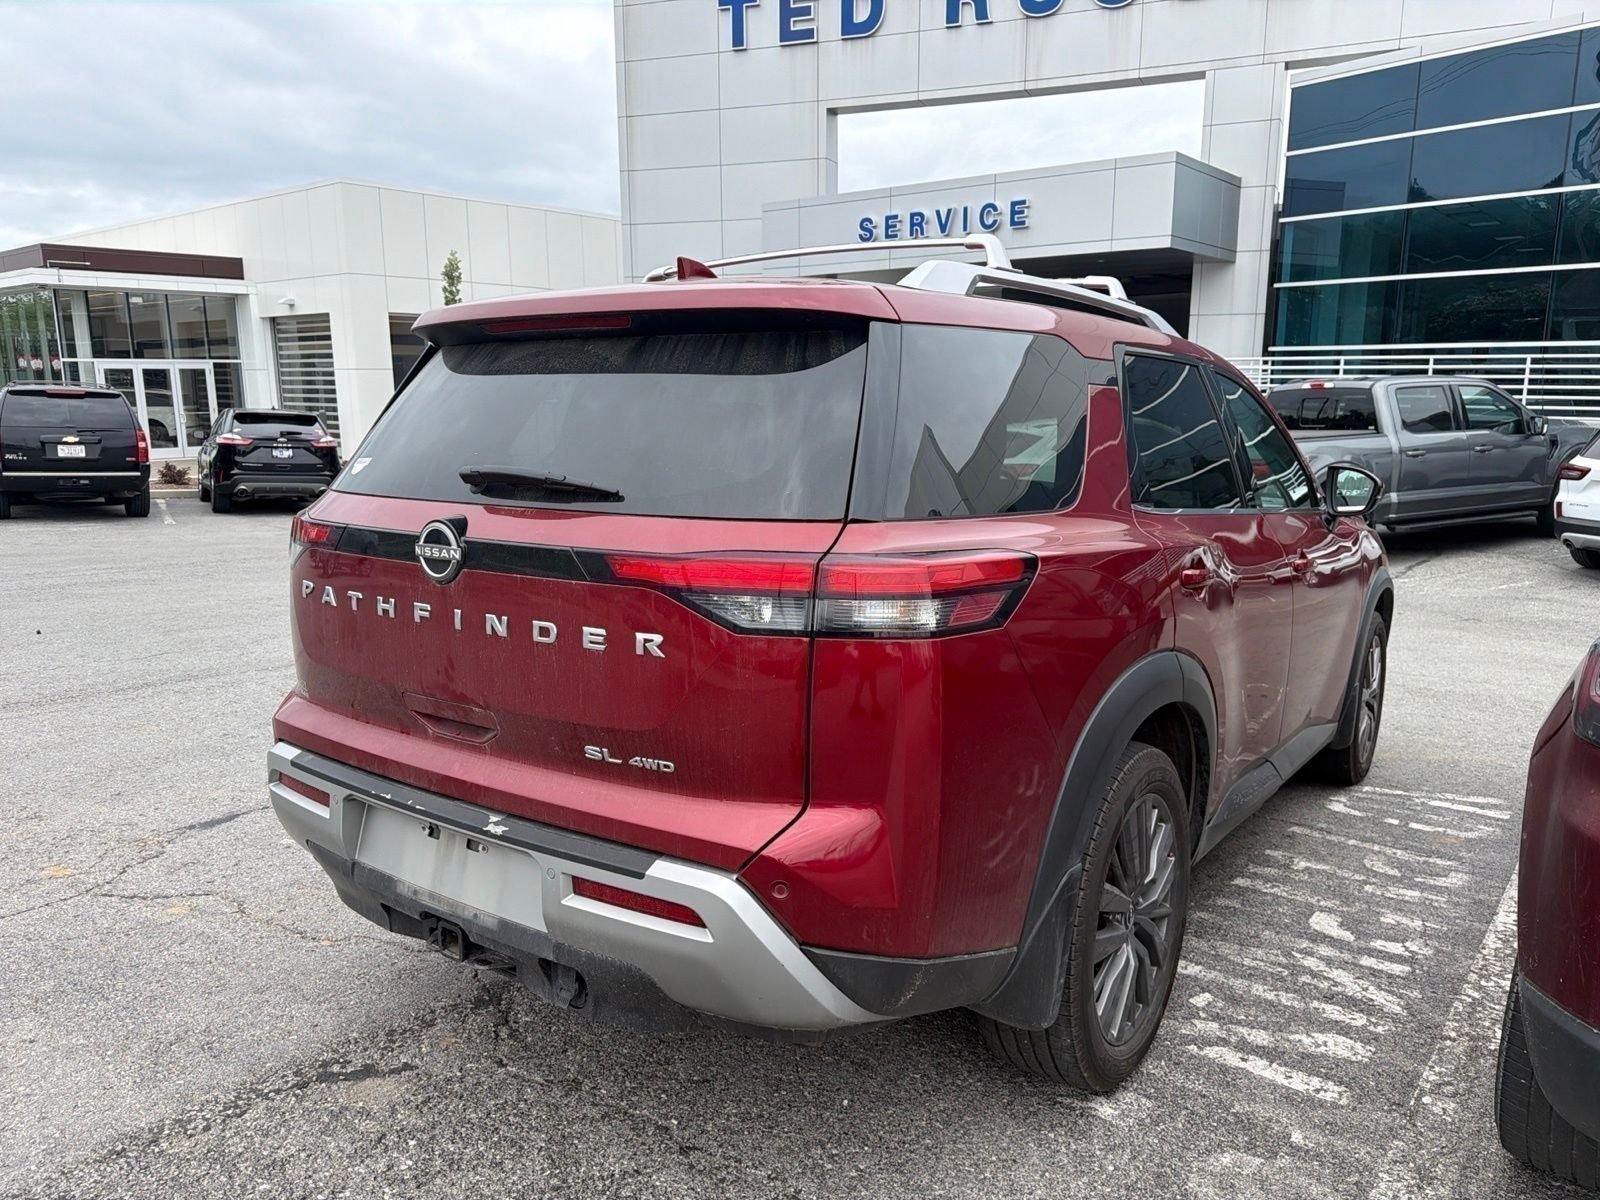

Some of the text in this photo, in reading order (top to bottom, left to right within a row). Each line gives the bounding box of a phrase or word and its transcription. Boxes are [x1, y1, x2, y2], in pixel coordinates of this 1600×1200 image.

[717, 0, 887, 50] TED
[858, 199, 1031, 243] SERVICE
[415, 545, 461, 561] NISSAN
[301, 579, 666, 658] PATHFINDER
[584, 745, 675, 773] SL 4WD
